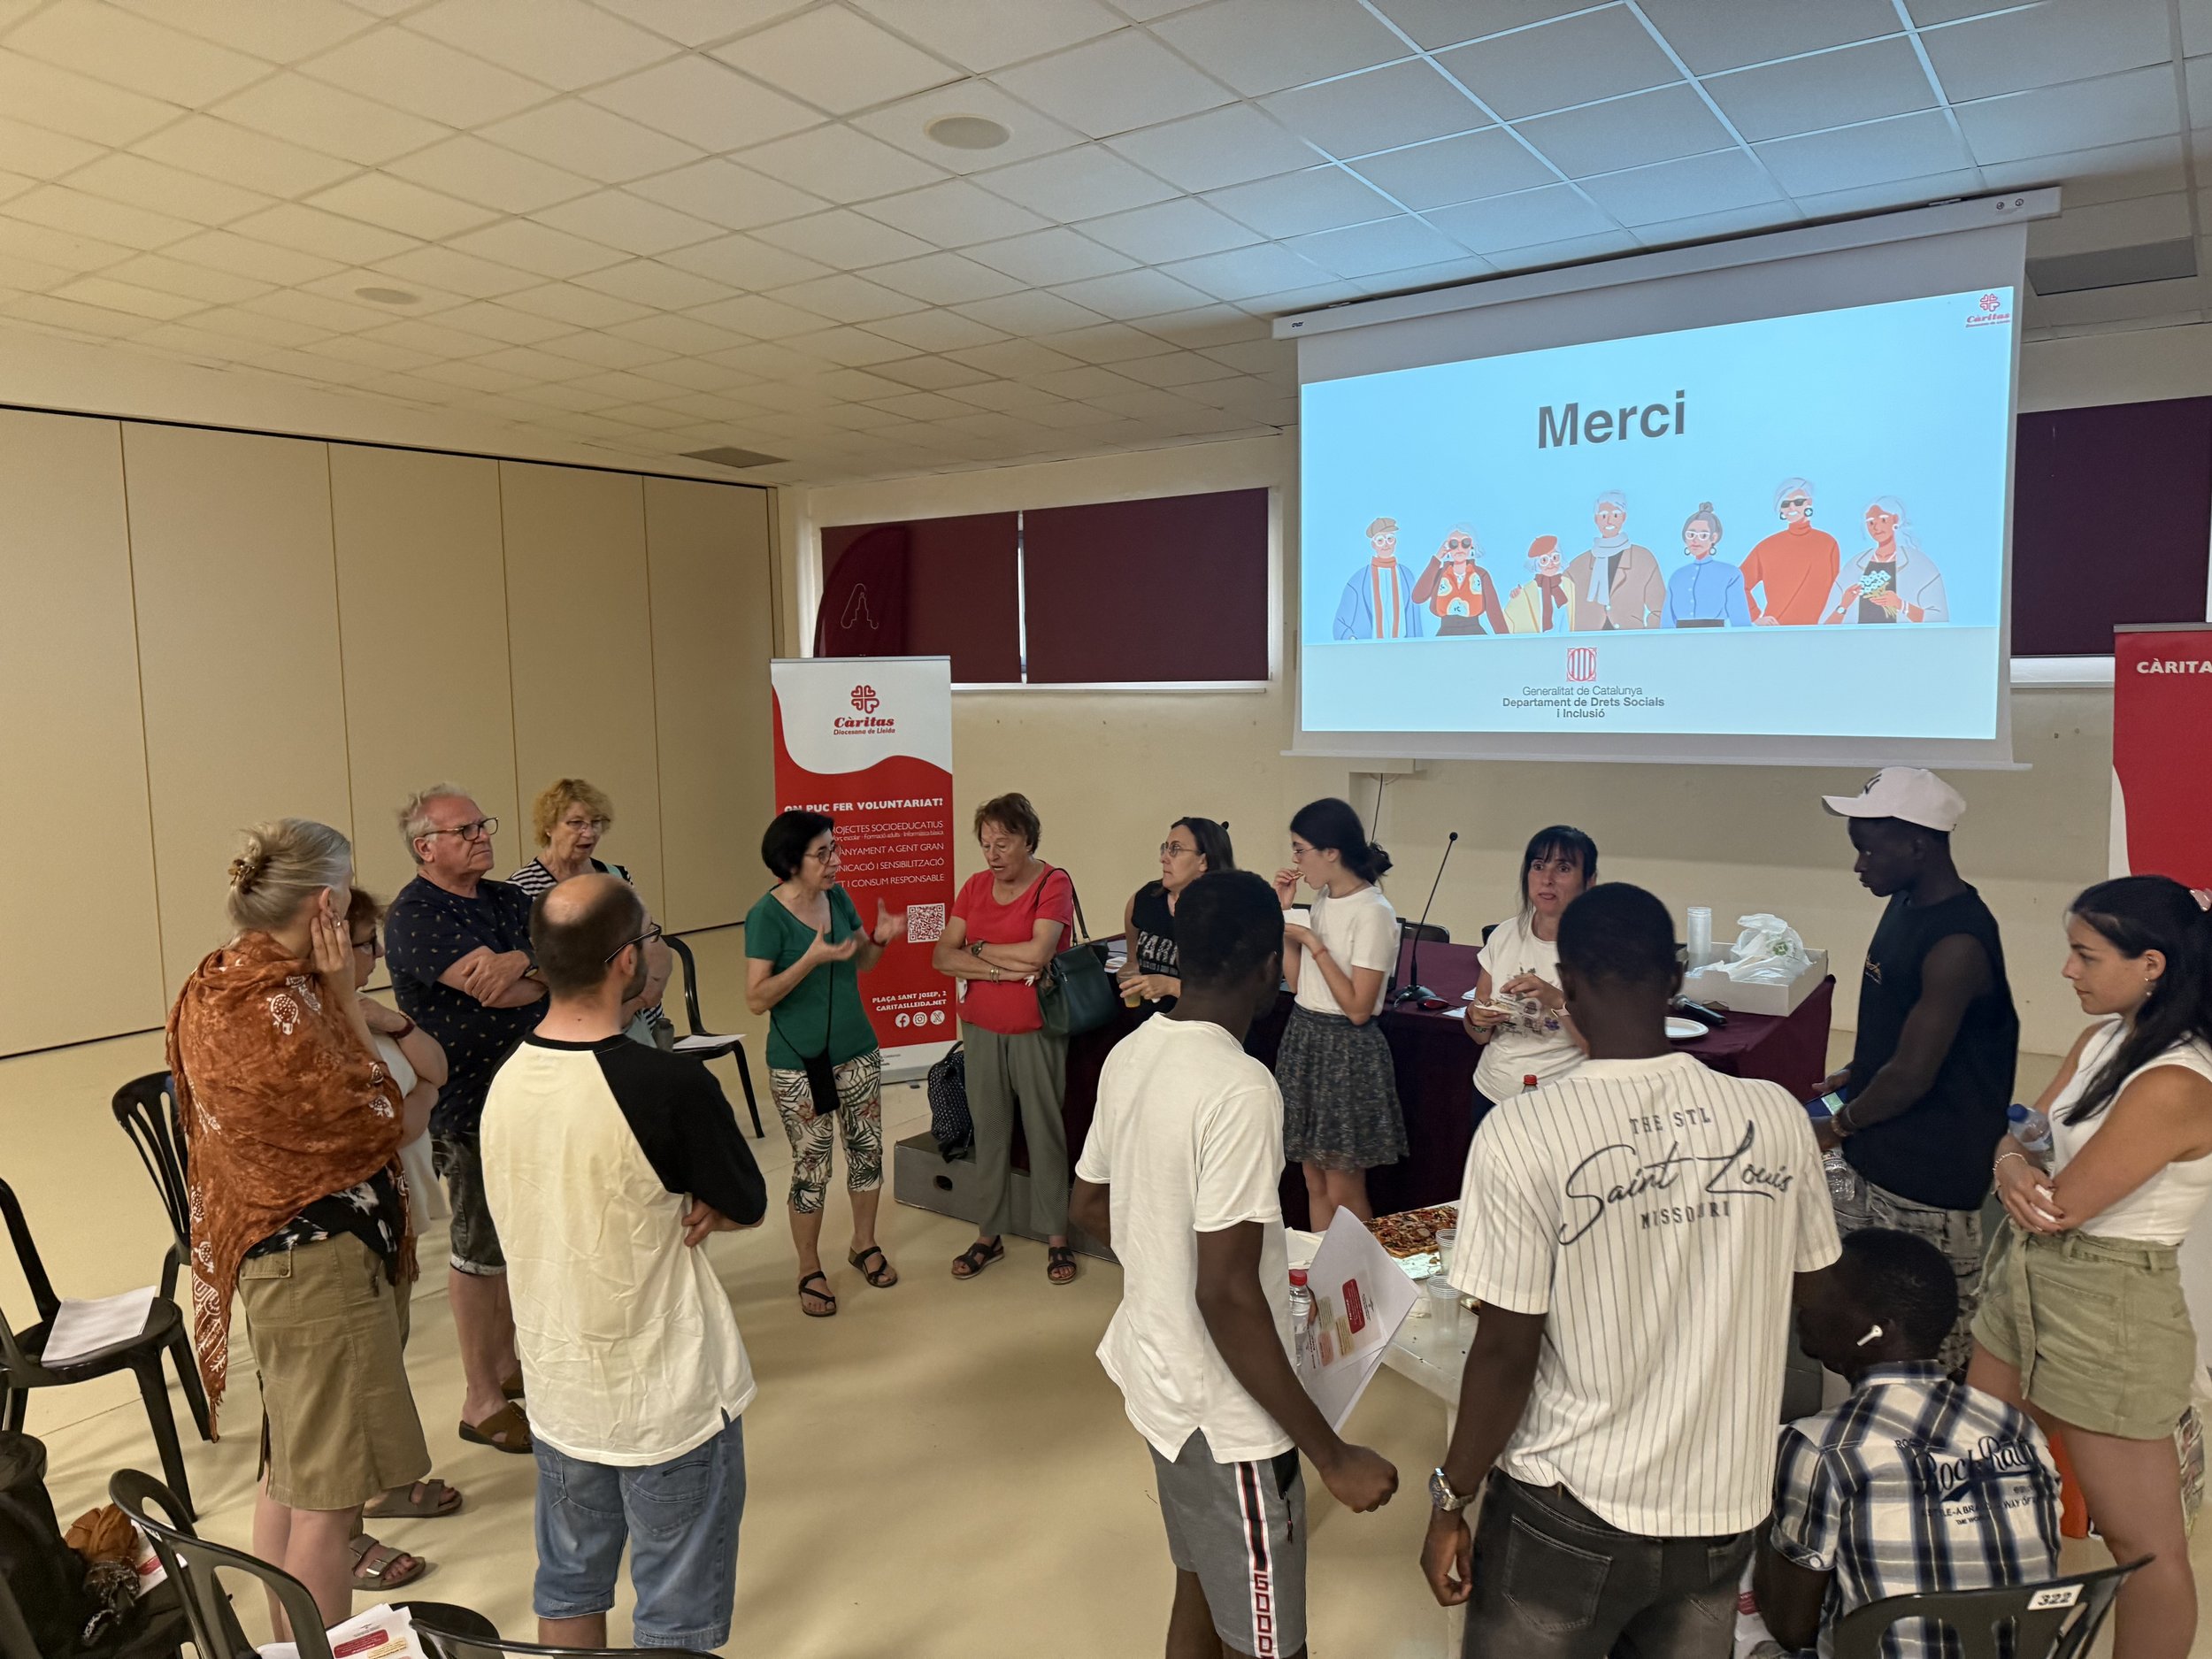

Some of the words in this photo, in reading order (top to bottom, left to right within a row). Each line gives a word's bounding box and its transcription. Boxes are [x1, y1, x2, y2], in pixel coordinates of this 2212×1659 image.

[1538, 389, 1686, 449] Merci
[2136, 657, 2212, 674] CÀRITA
[1522, 686, 1574, 696] Generalitat
[1577, 686, 1590, 695] de
[1592, 686, 1643, 697] Catalunya
[1502, 697, 1571, 709] Departament
[1573, 697, 1587, 707] de
[1591, 697, 1621, 707] Drets
[1623, 696, 1665, 707] Socials
[1556, 709, 1560, 718] i
[1563, 709, 1605, 718] Inclusió
[833, 717, 895, 728] Càritas
[806, 803, 830, 813] PUC
[833, 802, 854, 811] FER
[833, 825, 870, 835] OJECTES
[872, 821, 943, 833] SOCIOEDUCATIUS
[840, 847, 887, 856] ANYAMENT
[920, 842, 944, 851] GRAN
[880, 856, 945, 870] SENSIBILITZACIÓ
[851, 877, 889, 887] CONSUM
[890, 873, 945, 885] RESPONSABLE
[1629, 1114, 1663, 1135] THE
[1673, 1107, 1711, 1128] STL
[1558, 1141, 1694, 1246] Saint
[1696, 1119, 1793, 1203] Louis
[1640, 1200, 1731, 1230] MISSOURI
[2037, 1592, 2072, 1606] 322
